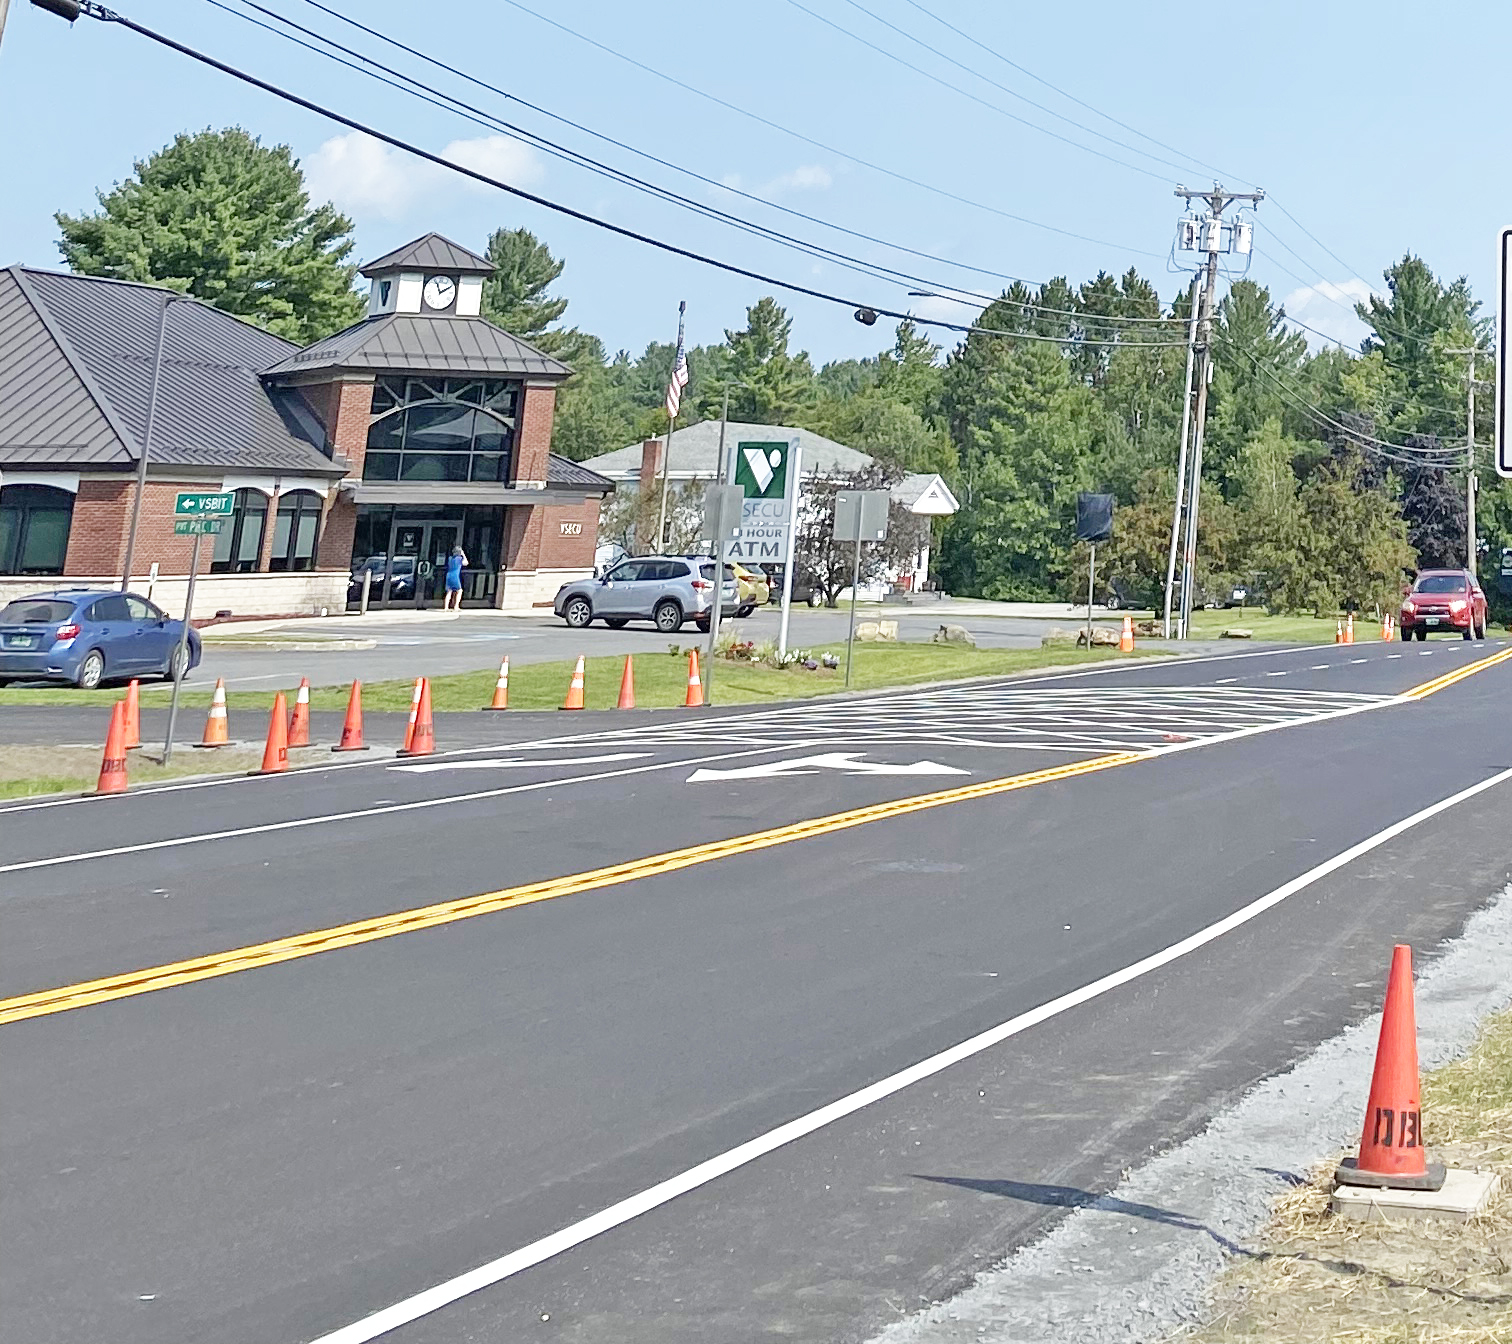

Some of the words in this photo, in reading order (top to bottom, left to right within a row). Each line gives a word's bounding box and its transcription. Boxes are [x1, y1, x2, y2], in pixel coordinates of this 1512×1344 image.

[198, 497, 229, 510] VSBIT
[743, 502, 785, 518] SECU
[746, 528, 783, 538] HOUR
[727, 541, 780, 557] ATM
